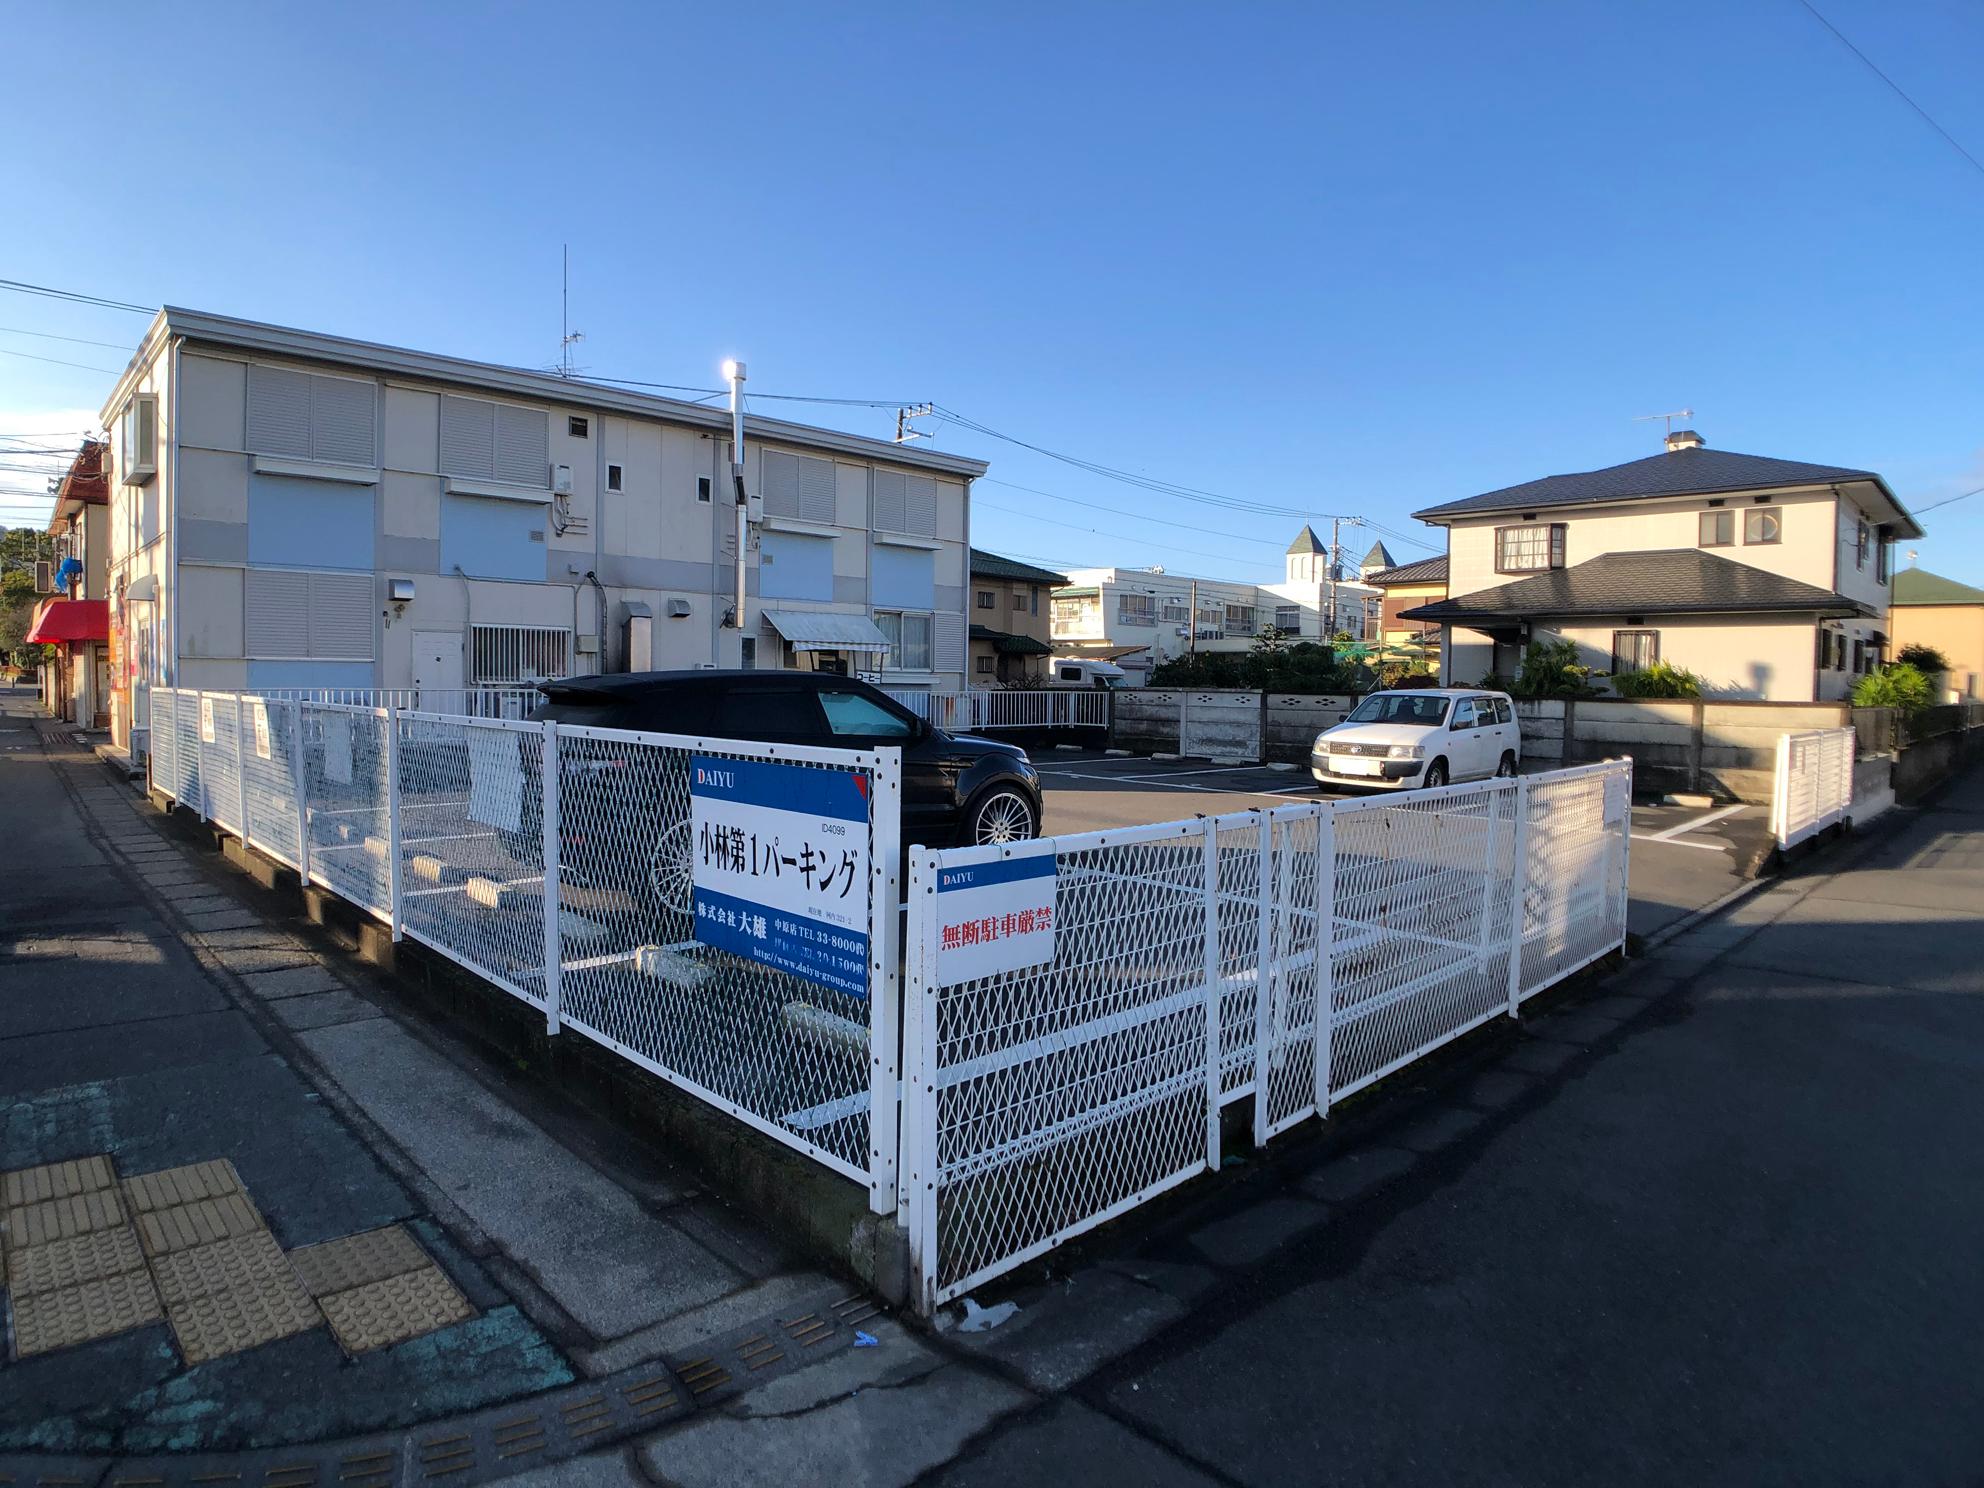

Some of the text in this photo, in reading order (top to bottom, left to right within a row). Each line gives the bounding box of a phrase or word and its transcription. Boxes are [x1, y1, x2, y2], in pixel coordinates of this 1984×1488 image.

[857, 673, 880, 682] コーヒー
[697, 768, 734, 789] DAIYU
[821, 823, 846, 837] ID4099
[699, 821, 858, 899] 小林第1パーキング
[943, 871, 974, 886] DAIYU
[799, 926, 815, 941] TEL
[941, 906, 1052, 951] 無断駐車厳禁
